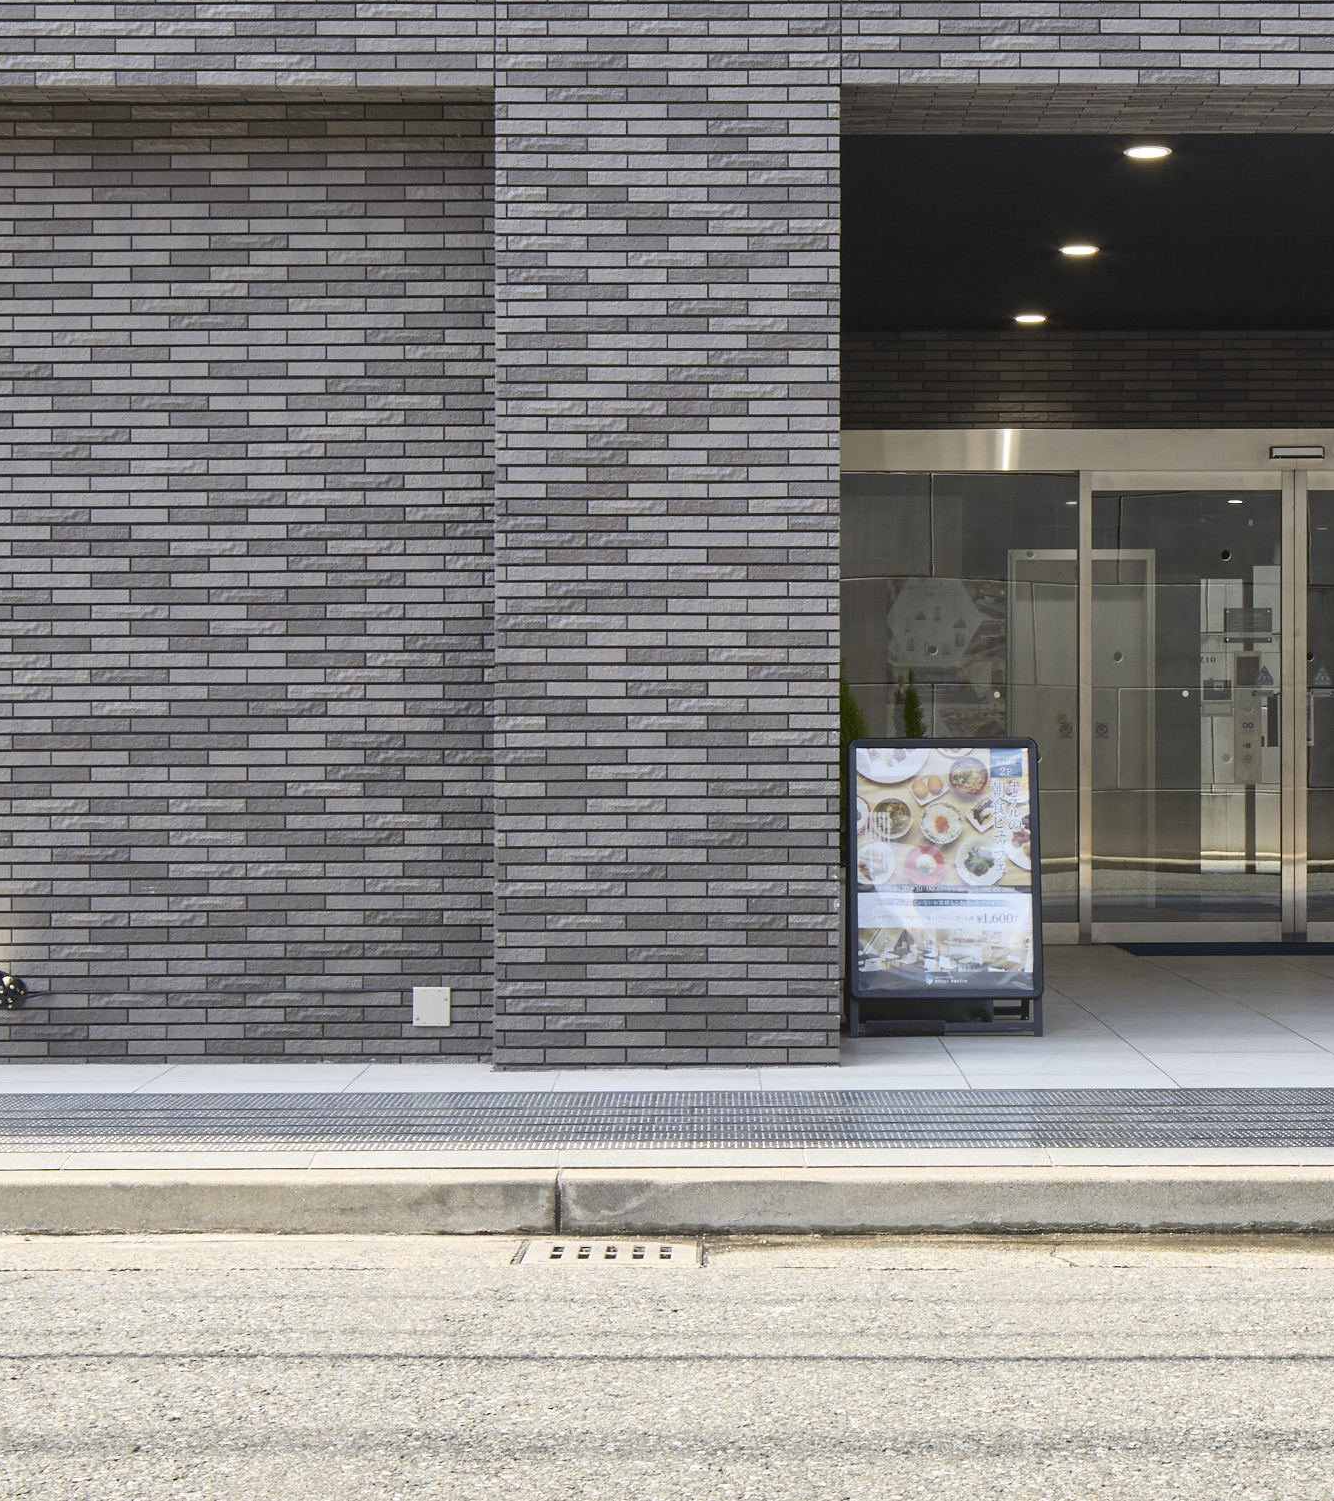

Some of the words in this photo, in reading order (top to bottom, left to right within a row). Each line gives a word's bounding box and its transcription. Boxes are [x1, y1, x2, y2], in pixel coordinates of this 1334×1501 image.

[999, 766, 1013, 776] 2F
[991, 781, 1007, 872] 朝食ビュッフェ
[1008, 781, 1022, 831] ホテルの
